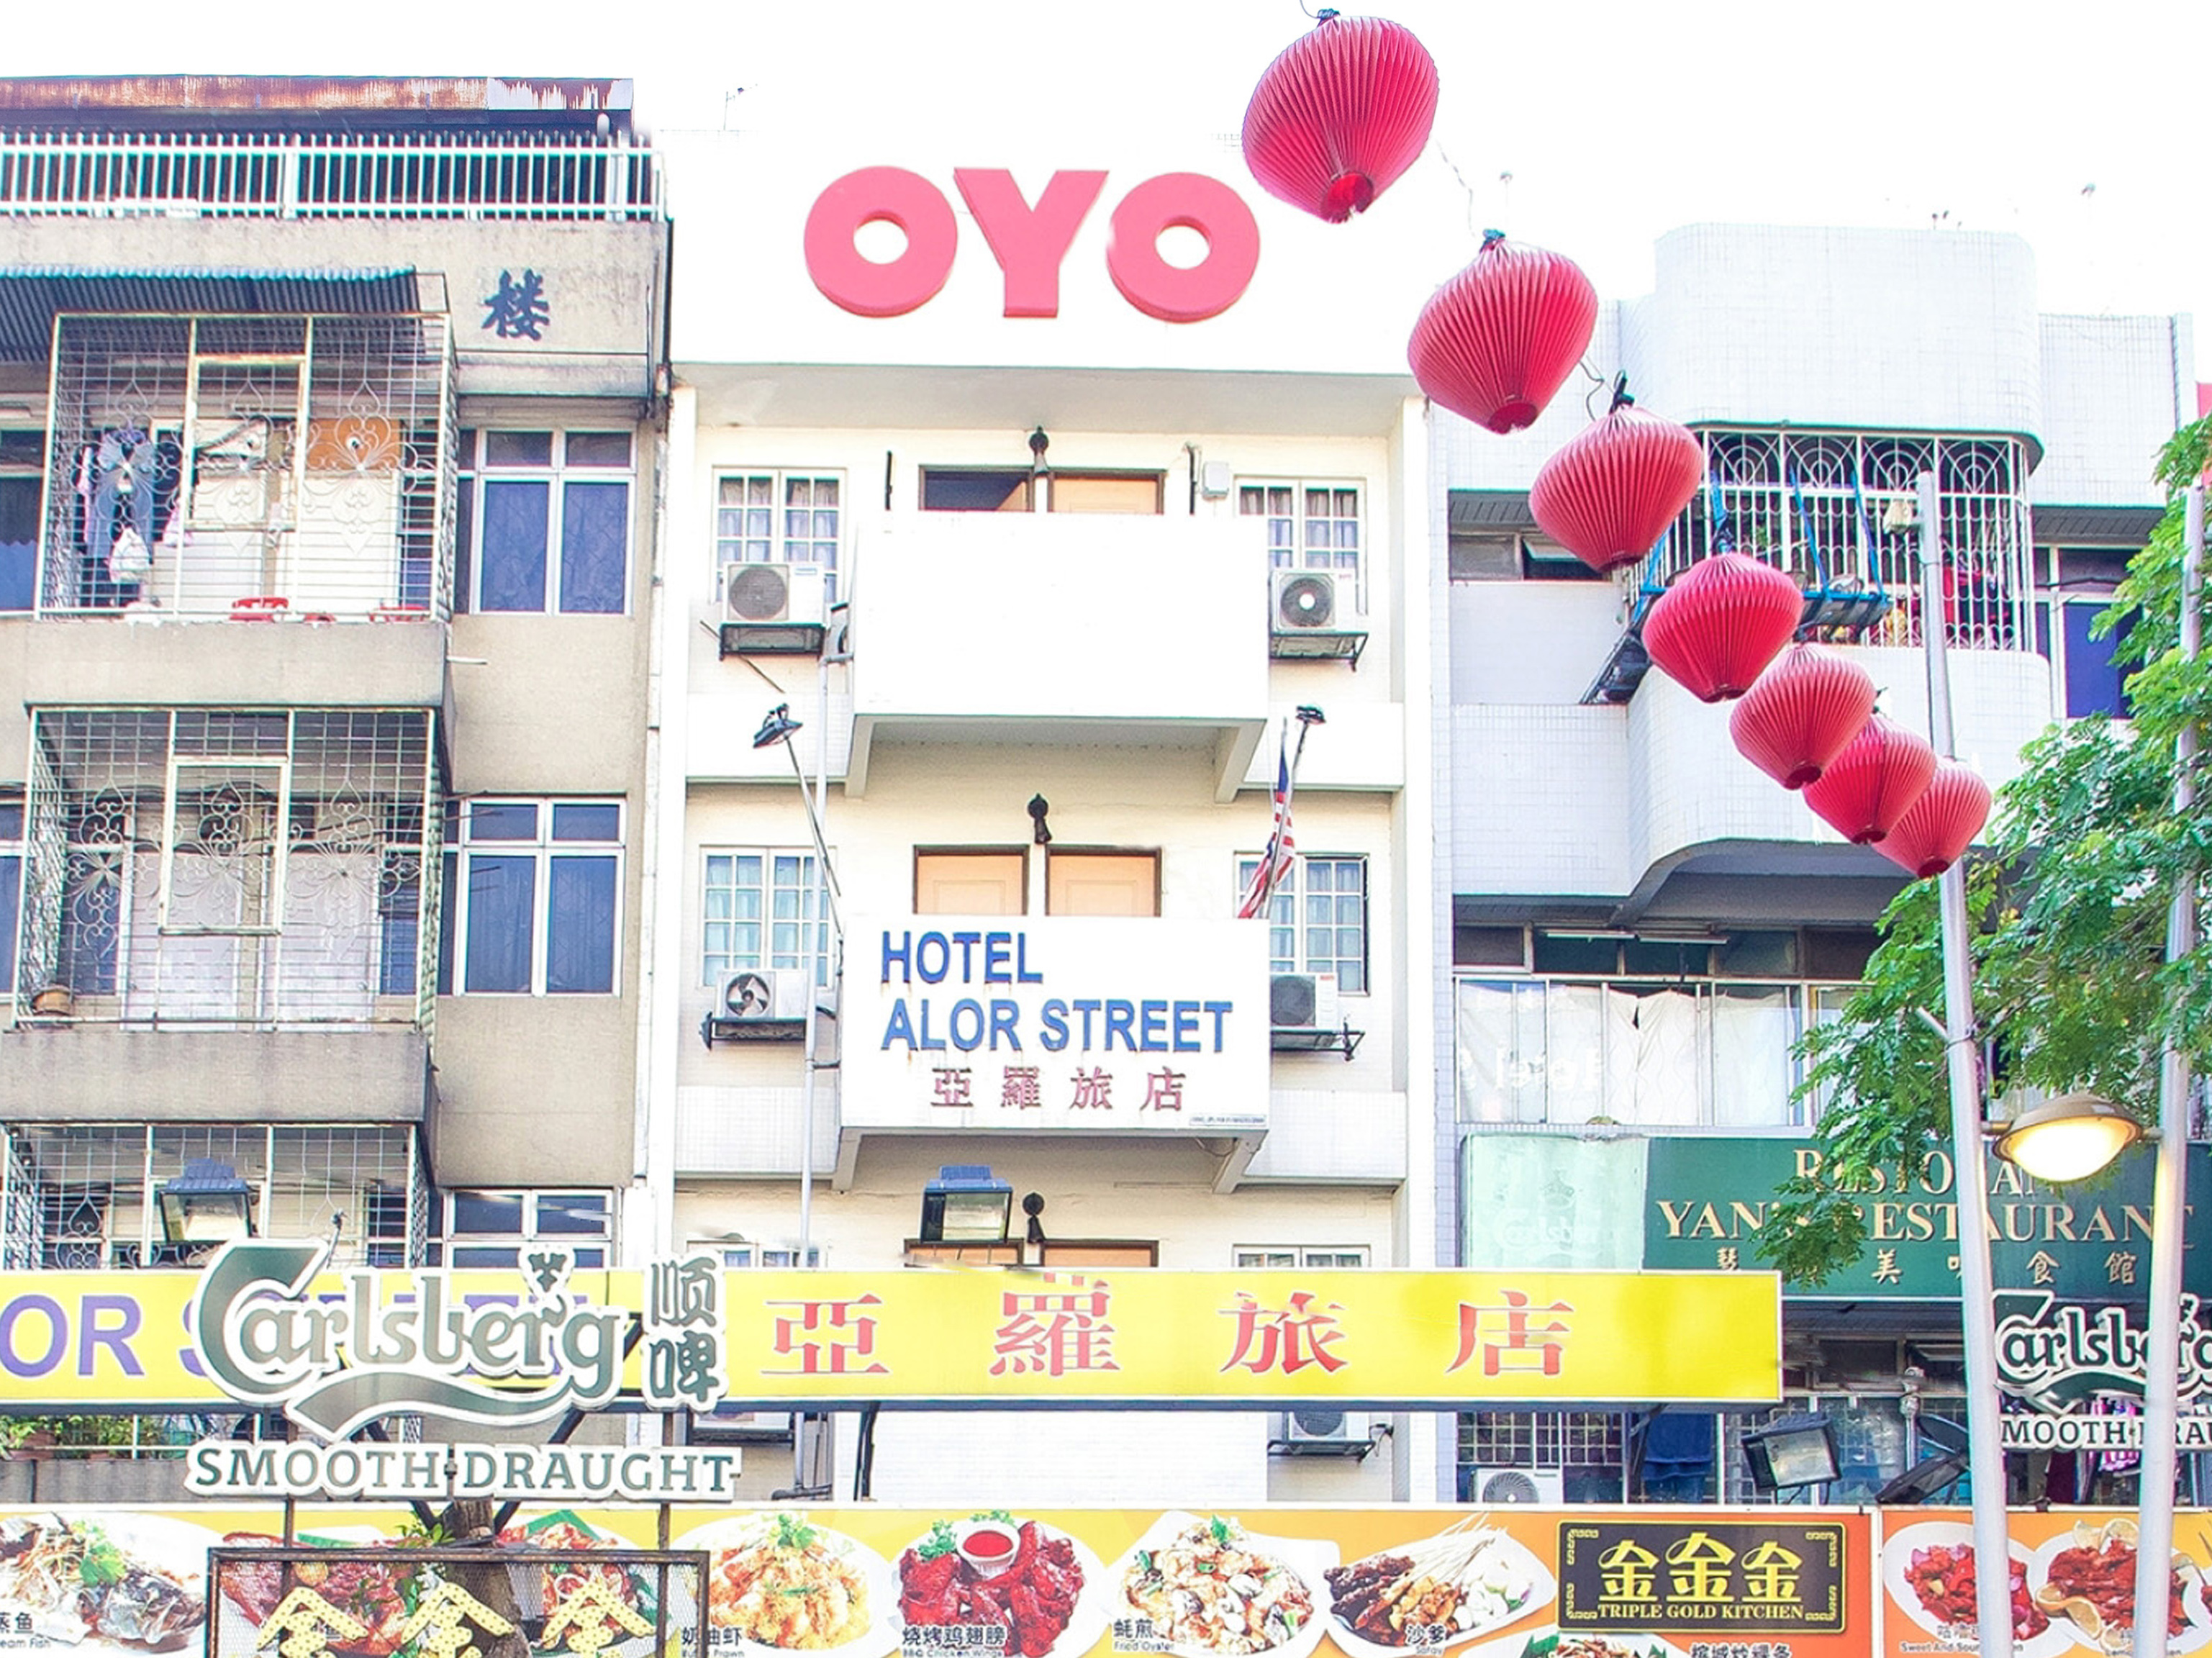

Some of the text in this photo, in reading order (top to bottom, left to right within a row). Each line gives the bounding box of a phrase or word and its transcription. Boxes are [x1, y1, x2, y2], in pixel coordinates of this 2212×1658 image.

[804, 166, 1261, 325] OYO
[481, 268, 550, 341] 楼
[881, 931, 1043, 984] HOTEL
[881, 998, 1233, 1053] ALOR STREET
[930, 1066, 1187, 1111] 亞羅旅店
[1833, 1201, 2195, 1248] ESTURAN
[0, 1294, 145, 1377] OR
[199, 1246, 616, 1399] Carlsberg
[761, 1272, 1574, 1377] 亞羅旅店
[1992, 1292, 2212, 1394] Carlsbg
[2000, 1421, 2126, 1445] MOOTH
[196, 1448, 733, 1492] SMOOTH DRAUGHT
[1597, 1532, 1803, 1603] 金金金
[1597, 1604, 1804, 1619] TRIPLE GOLD KITCHEN
